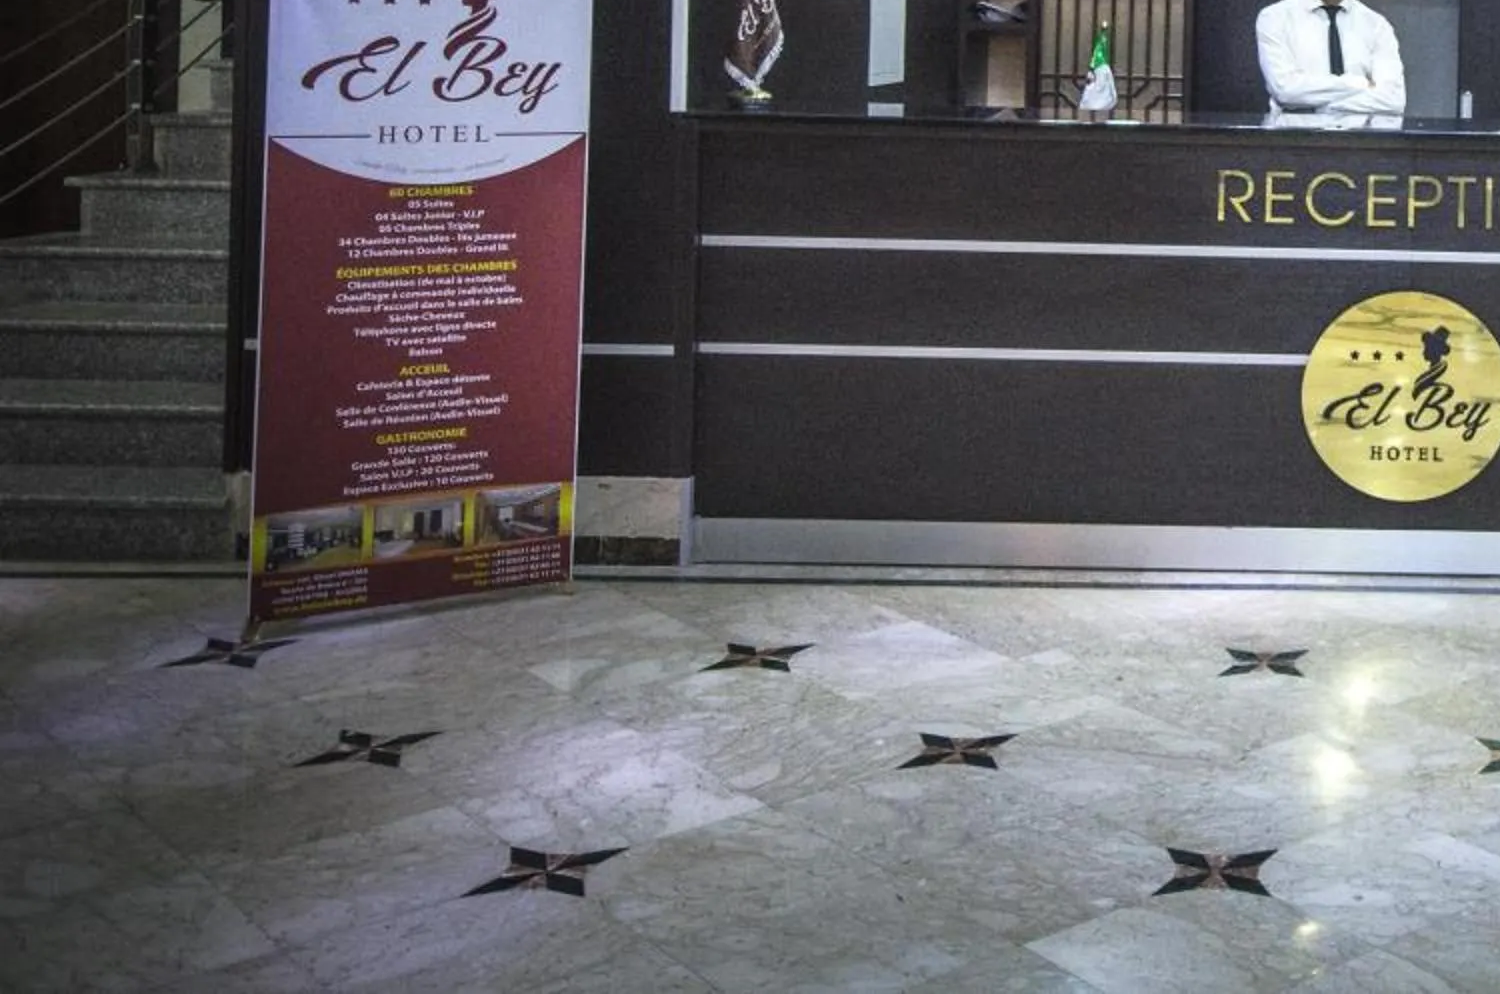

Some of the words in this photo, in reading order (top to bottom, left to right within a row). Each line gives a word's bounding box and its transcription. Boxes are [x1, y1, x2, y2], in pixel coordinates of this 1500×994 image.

[302, 36, 427, 102] El
[432, 35, 562, 114] Bey
[378, 124, 491, 144] HOTEL
[354, 235, 406, 245] Chambres
[362, 247, 414, 258] Chambres
[1324, 382, 1401, 430] El
[1405, 382, 1491, 440] Bey
[376, 427, 467, 445] GASTRONOMIE
[1370, 446, 1443, 461] HOTEL
